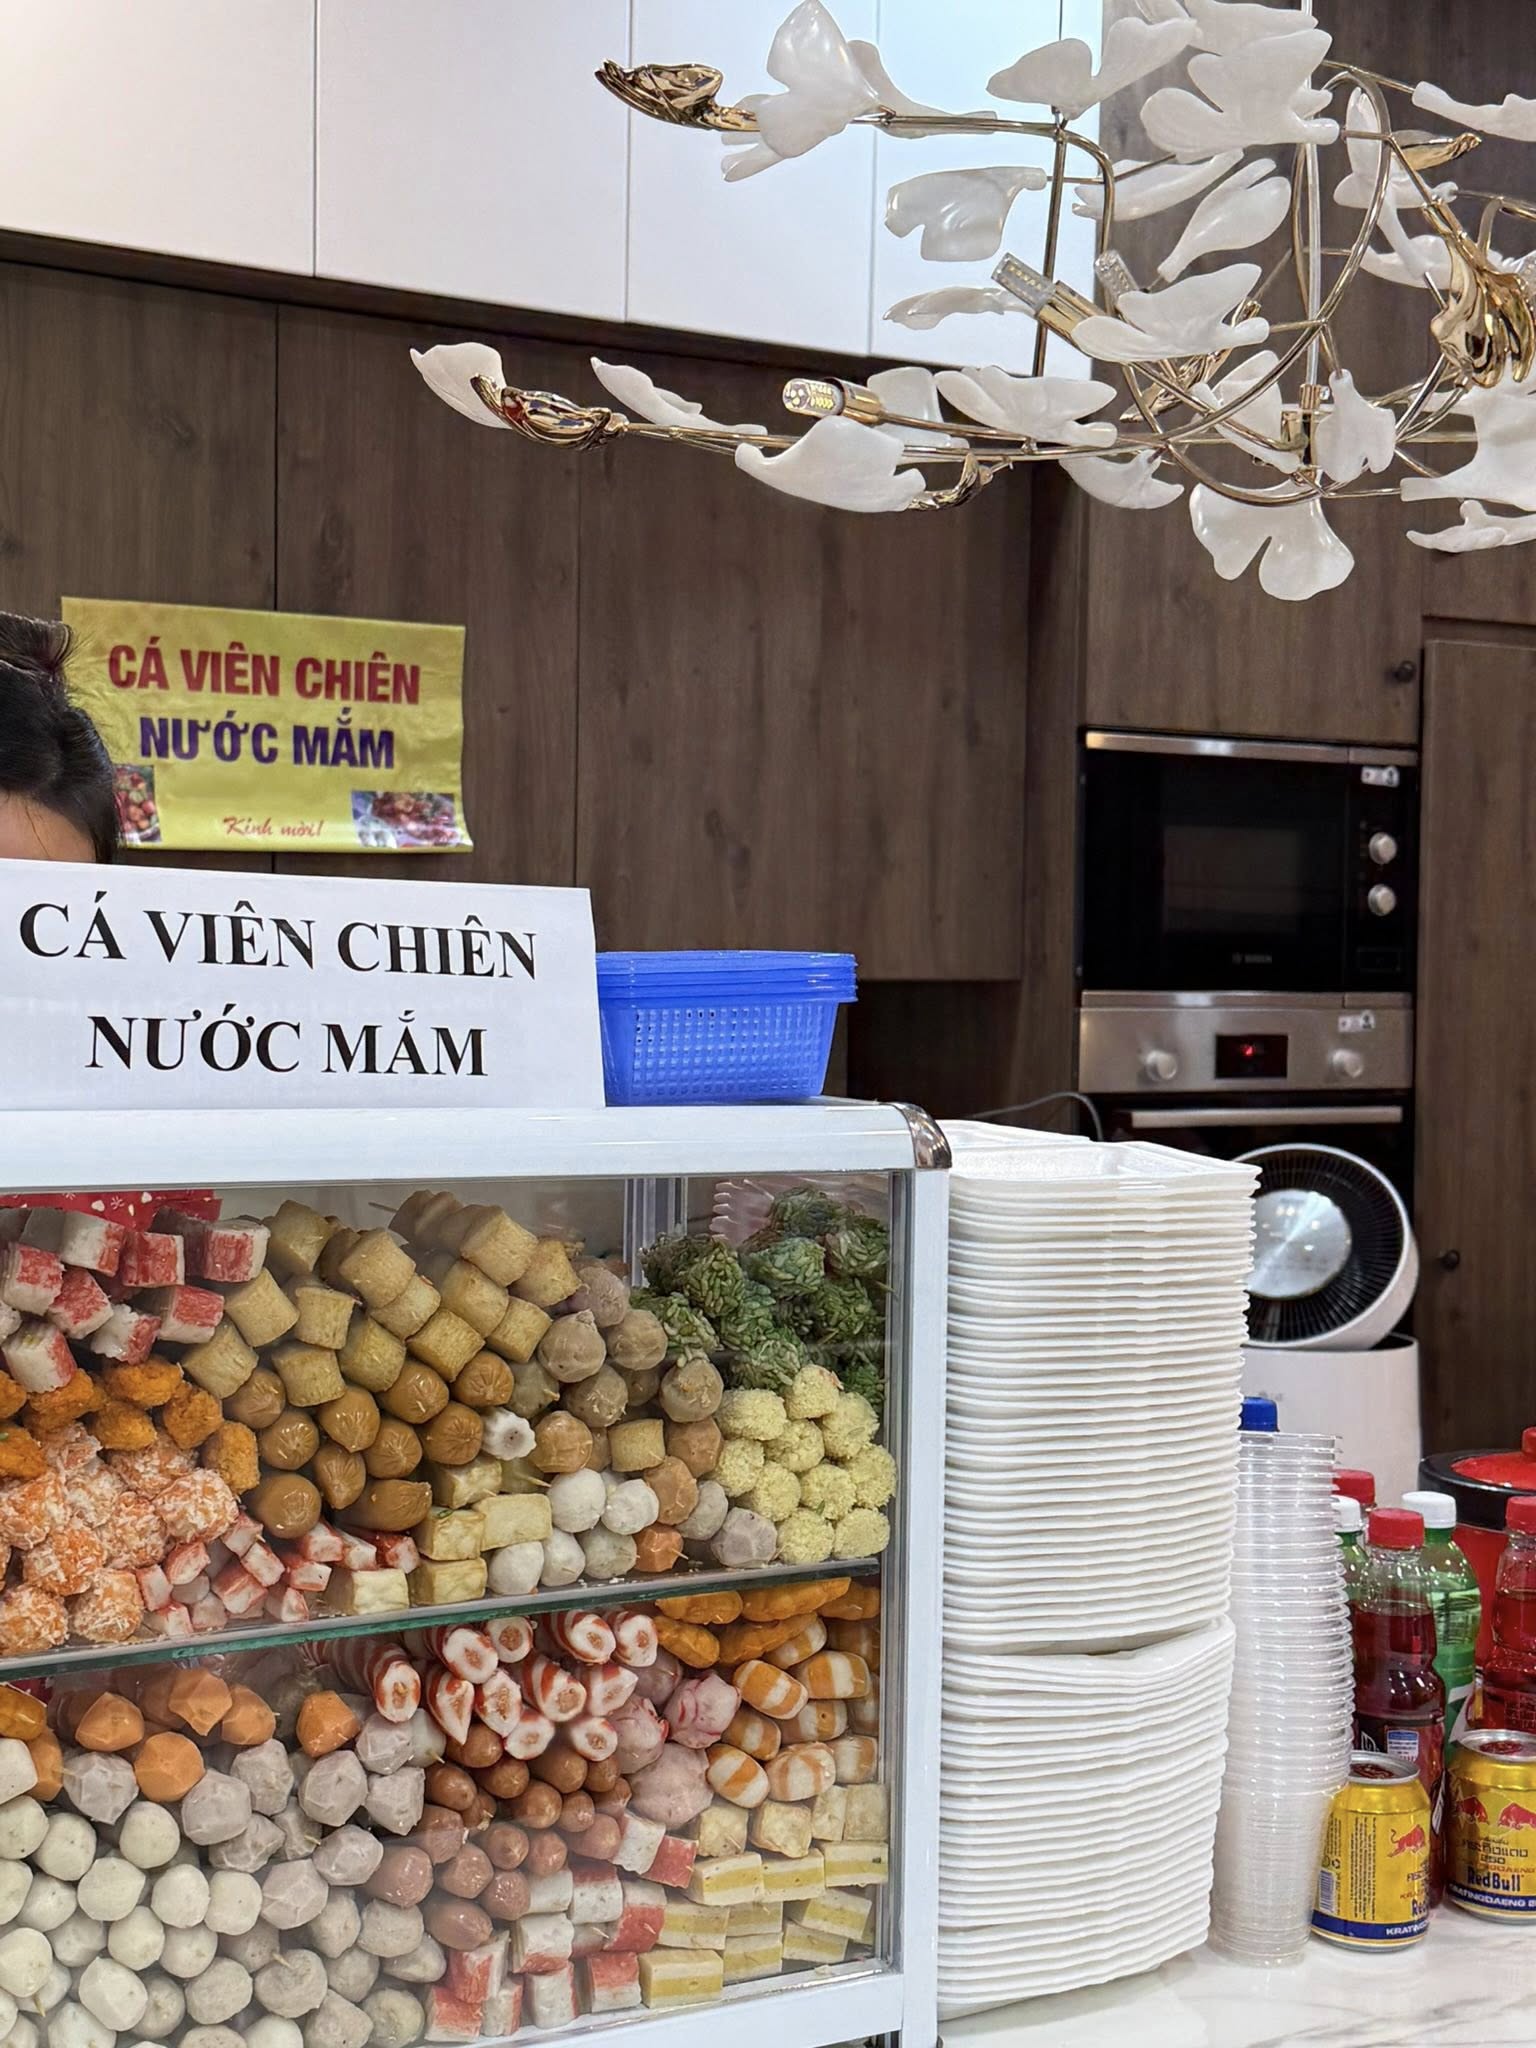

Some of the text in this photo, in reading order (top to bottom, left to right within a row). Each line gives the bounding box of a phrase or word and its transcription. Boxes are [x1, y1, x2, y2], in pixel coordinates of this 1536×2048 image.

[107, 635, 421, 705] CÁ VIÊN CHIÊN
[139, 707, 394, 769] NƯỚC MẮM
[19, 890, 536, 980] CÁ VIÊN CHIÊN
[86, 1003, 488, 1076] NƯỚC MẮM
